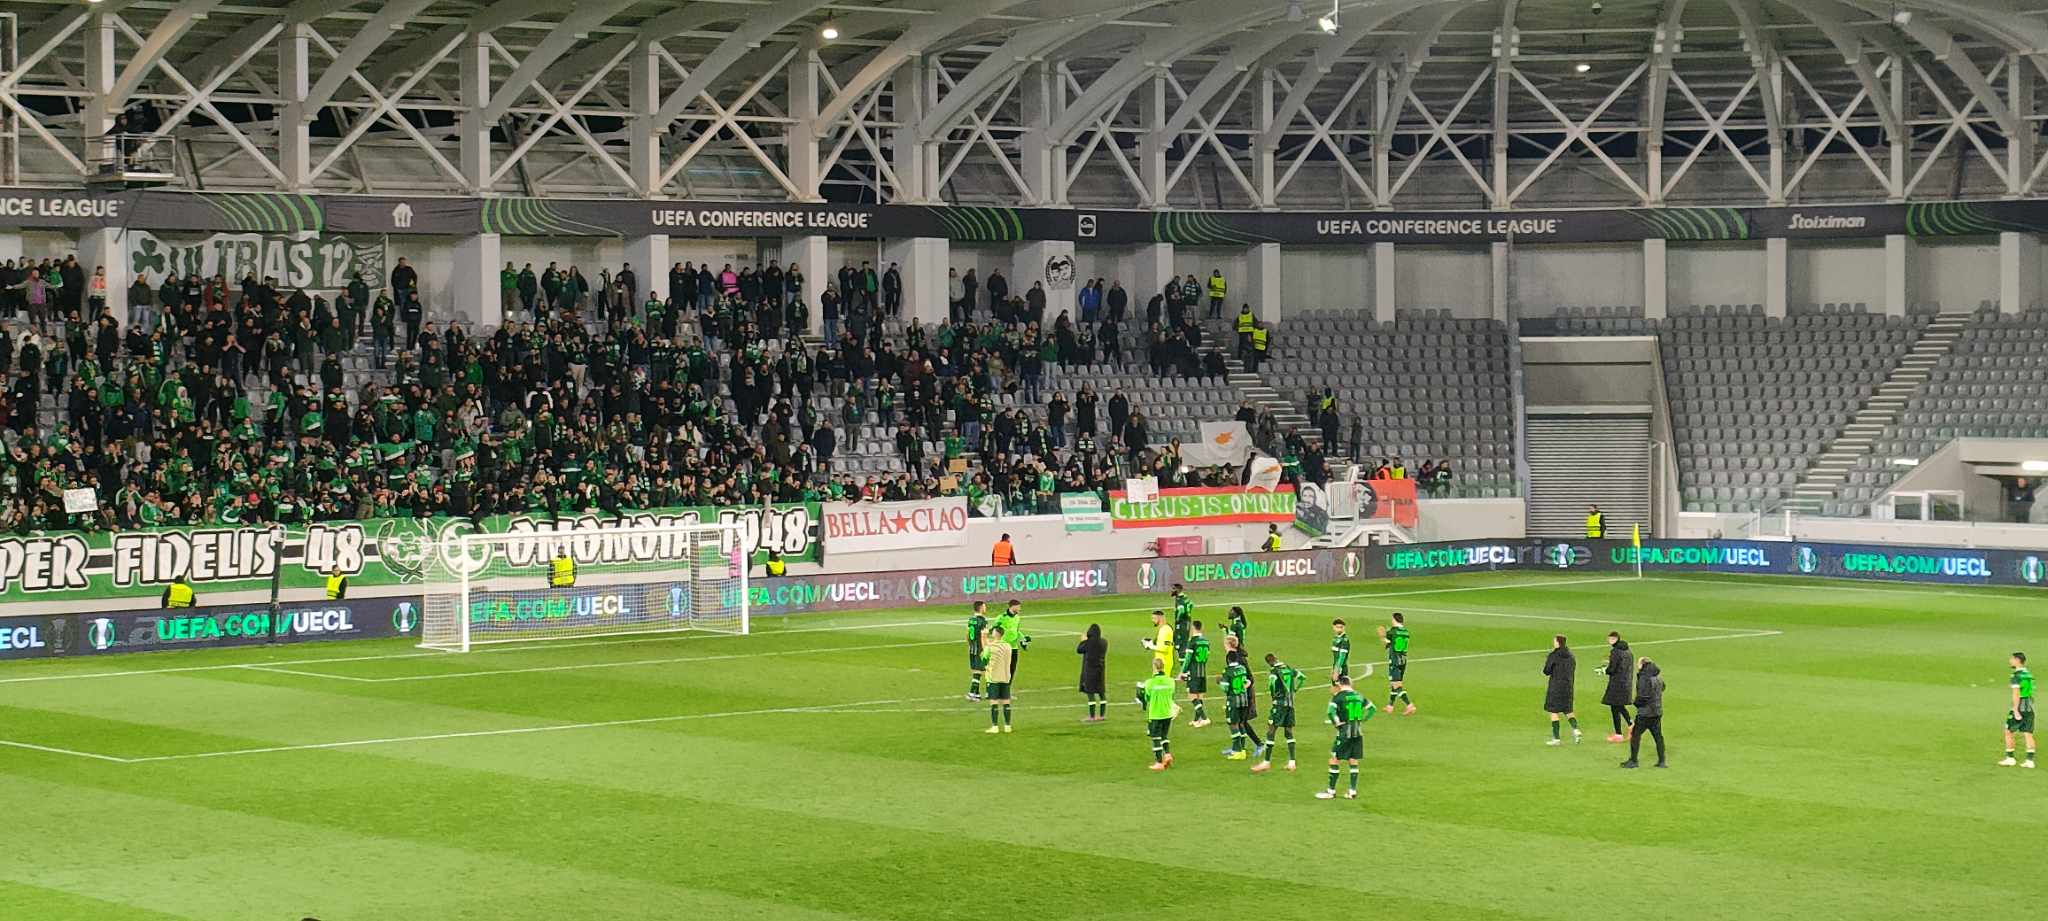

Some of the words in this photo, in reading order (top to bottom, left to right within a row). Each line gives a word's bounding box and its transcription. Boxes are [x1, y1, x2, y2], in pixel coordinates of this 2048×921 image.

[39, 198, 118, 217] LEAGUE
[652, 210, 696, 226] UEFA
[700, 211, 803, 227] CONFERENCE
[809, 212, 868, 228] LEAGUE
[1317, 220, 1362, 234] UEFA
[1366, 220, 1482, 234] CONFERENCE
[1787, 214, 1866, 230] Stoiximan
[320, 242, 352, 287] 12
[826, 510, 896, 538] BELLA
[911, 507, 967, 533] CIAO
[114, 528, 277, 585] FIDELIS
[304, 524, 364, 575] 48
[1611, 547, 1770, 566] UEFA.COM/UECL
[1843, 553, 1991, 576] UEFA.COM/UECL
[963, 569, 1108, 594] UEFA.COM/UECL
[1184, 558, 1317, 582] UEFA.COM/UECL
